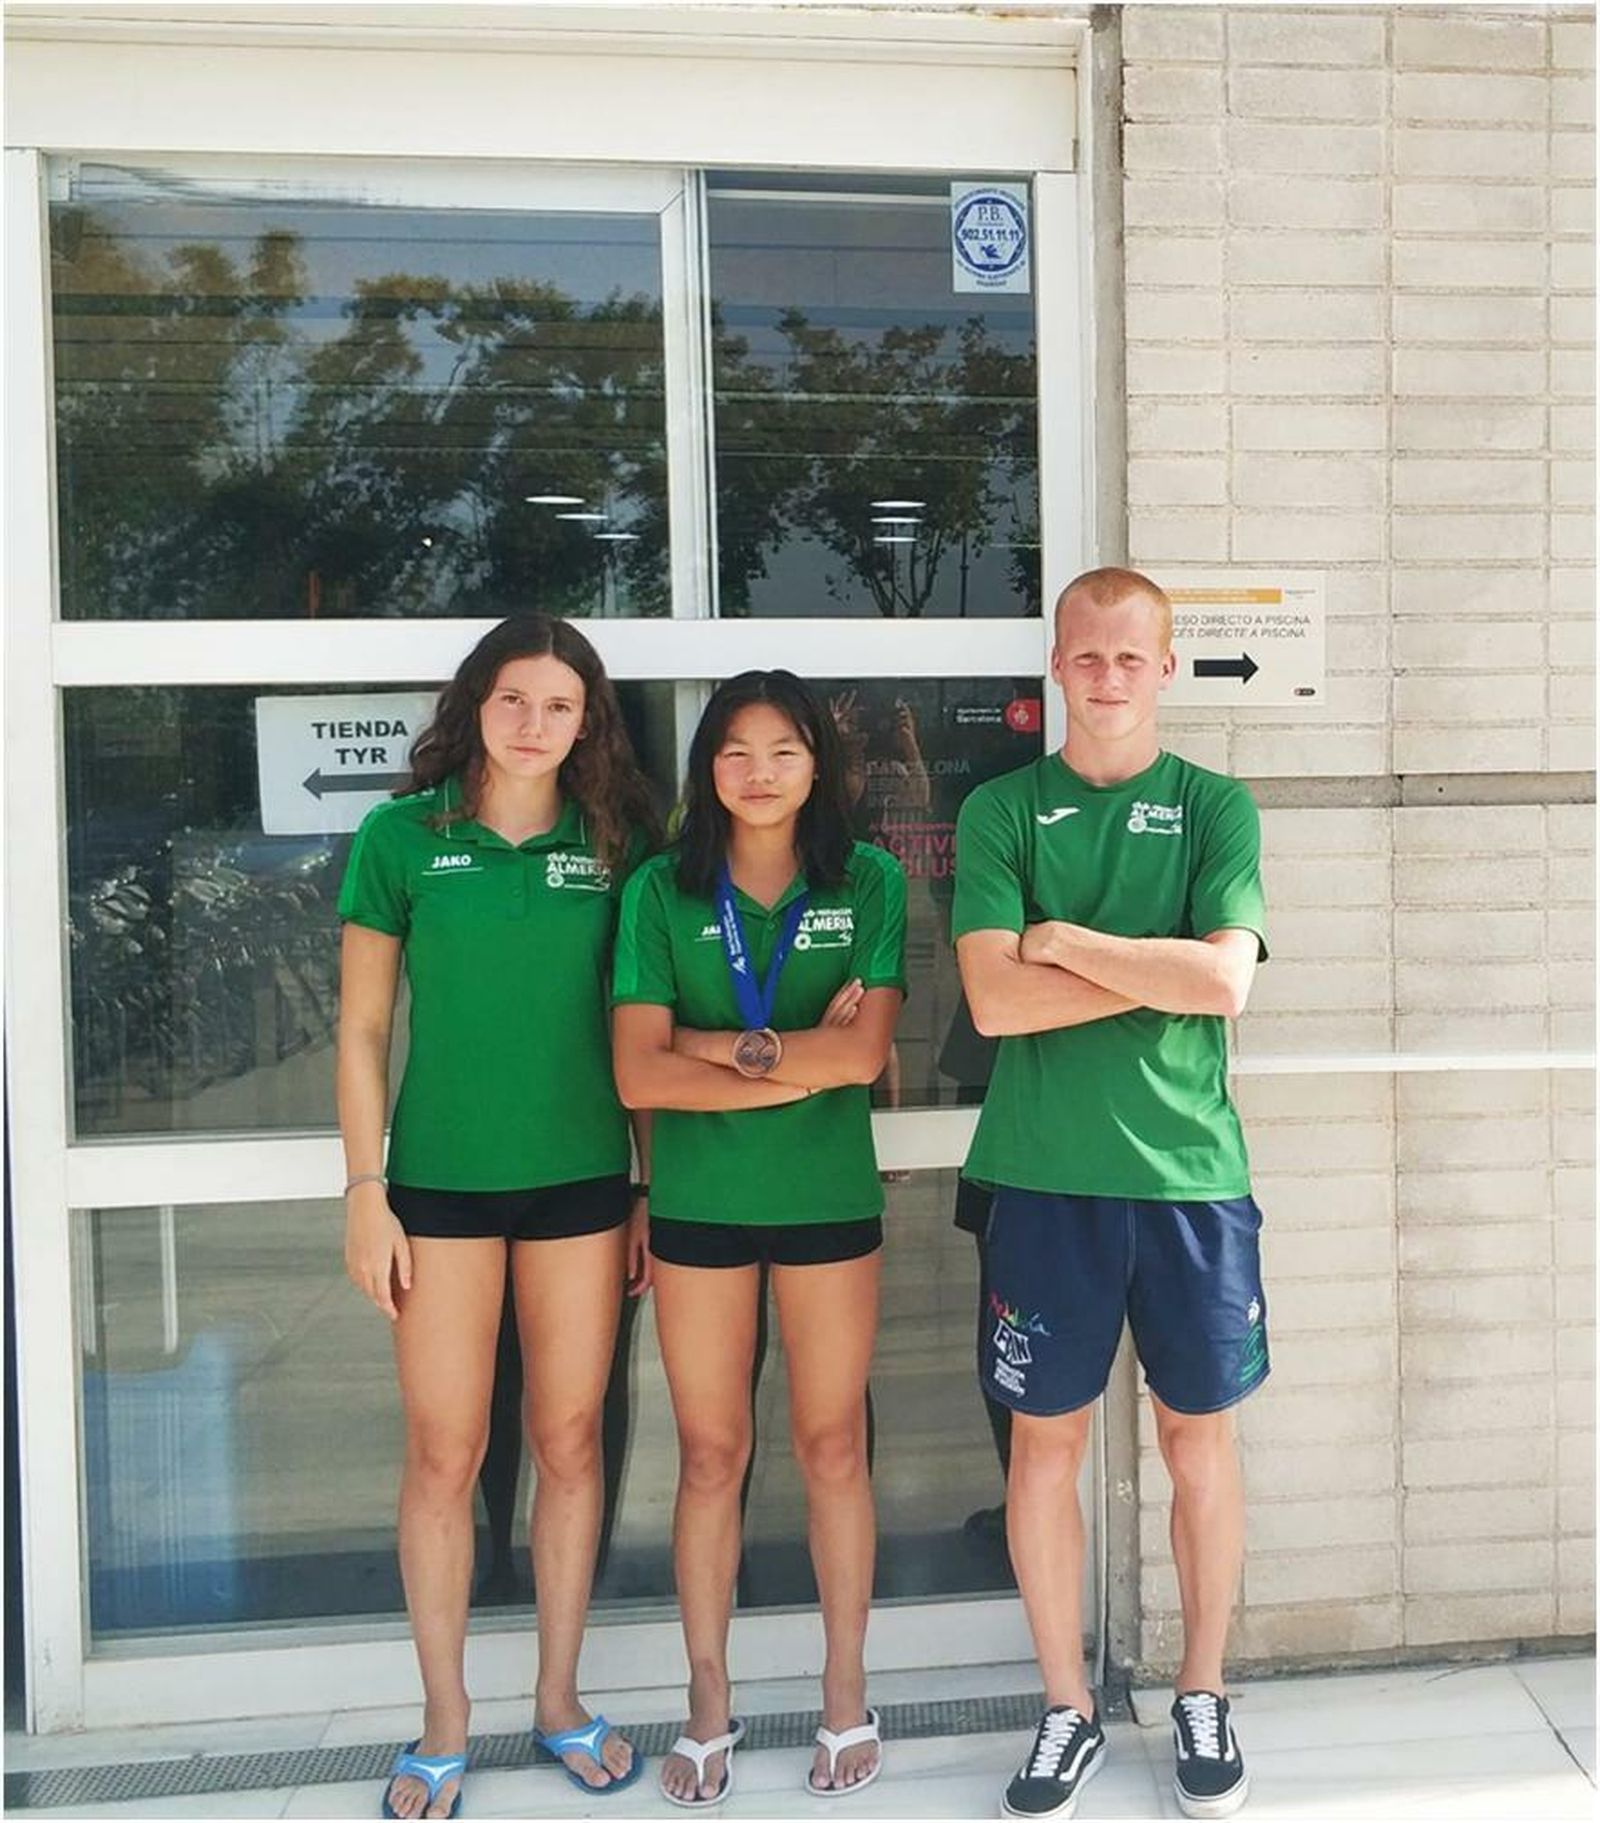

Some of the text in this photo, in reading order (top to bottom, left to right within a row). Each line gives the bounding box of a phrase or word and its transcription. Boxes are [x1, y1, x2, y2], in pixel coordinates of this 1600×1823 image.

[977, 205, 1004, 221] P.B.
[1173, 614, 1311, 625] ESO DIRECTO A PISCINA
[1249, 628, 1258, 638] A
[1260, 627, 1306, 638] PISCINA
[956, 714, 1002, 723] Barcelona
[311, 720, 409, 739] TIENDA
[335, 747, 388, 765] TYR
[432, 854, 472, 868] JAKO
